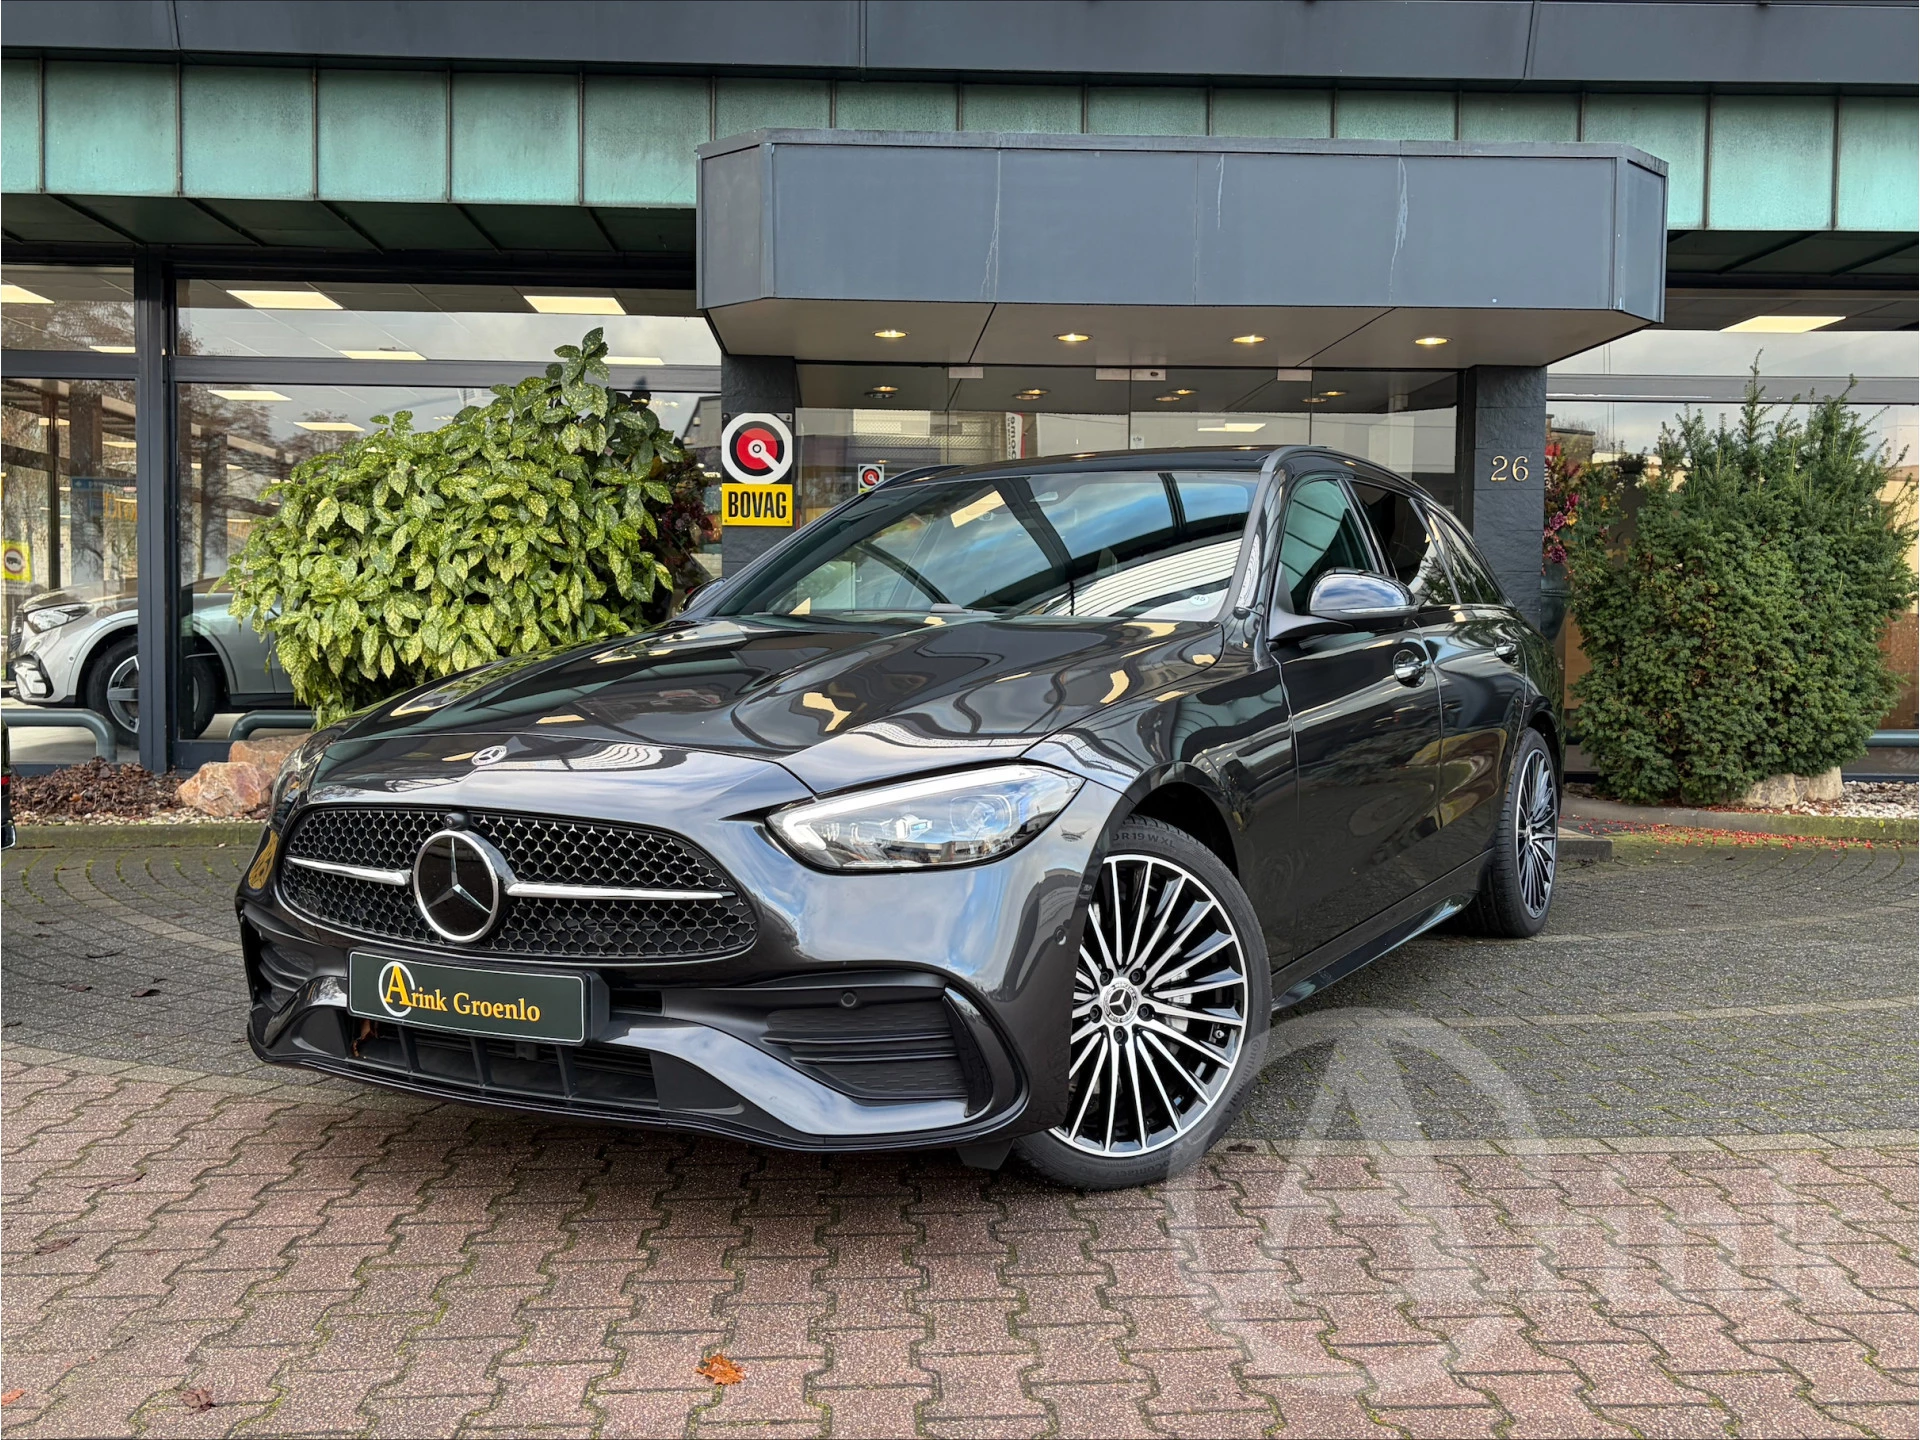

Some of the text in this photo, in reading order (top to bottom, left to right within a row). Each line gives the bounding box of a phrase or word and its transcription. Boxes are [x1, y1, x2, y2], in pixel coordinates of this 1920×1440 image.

[1490, 455, 1529, 482] 26
[728, 491, 787, 519] BOVAG
[381, 963, 541, 1022] Arink Groenlo
